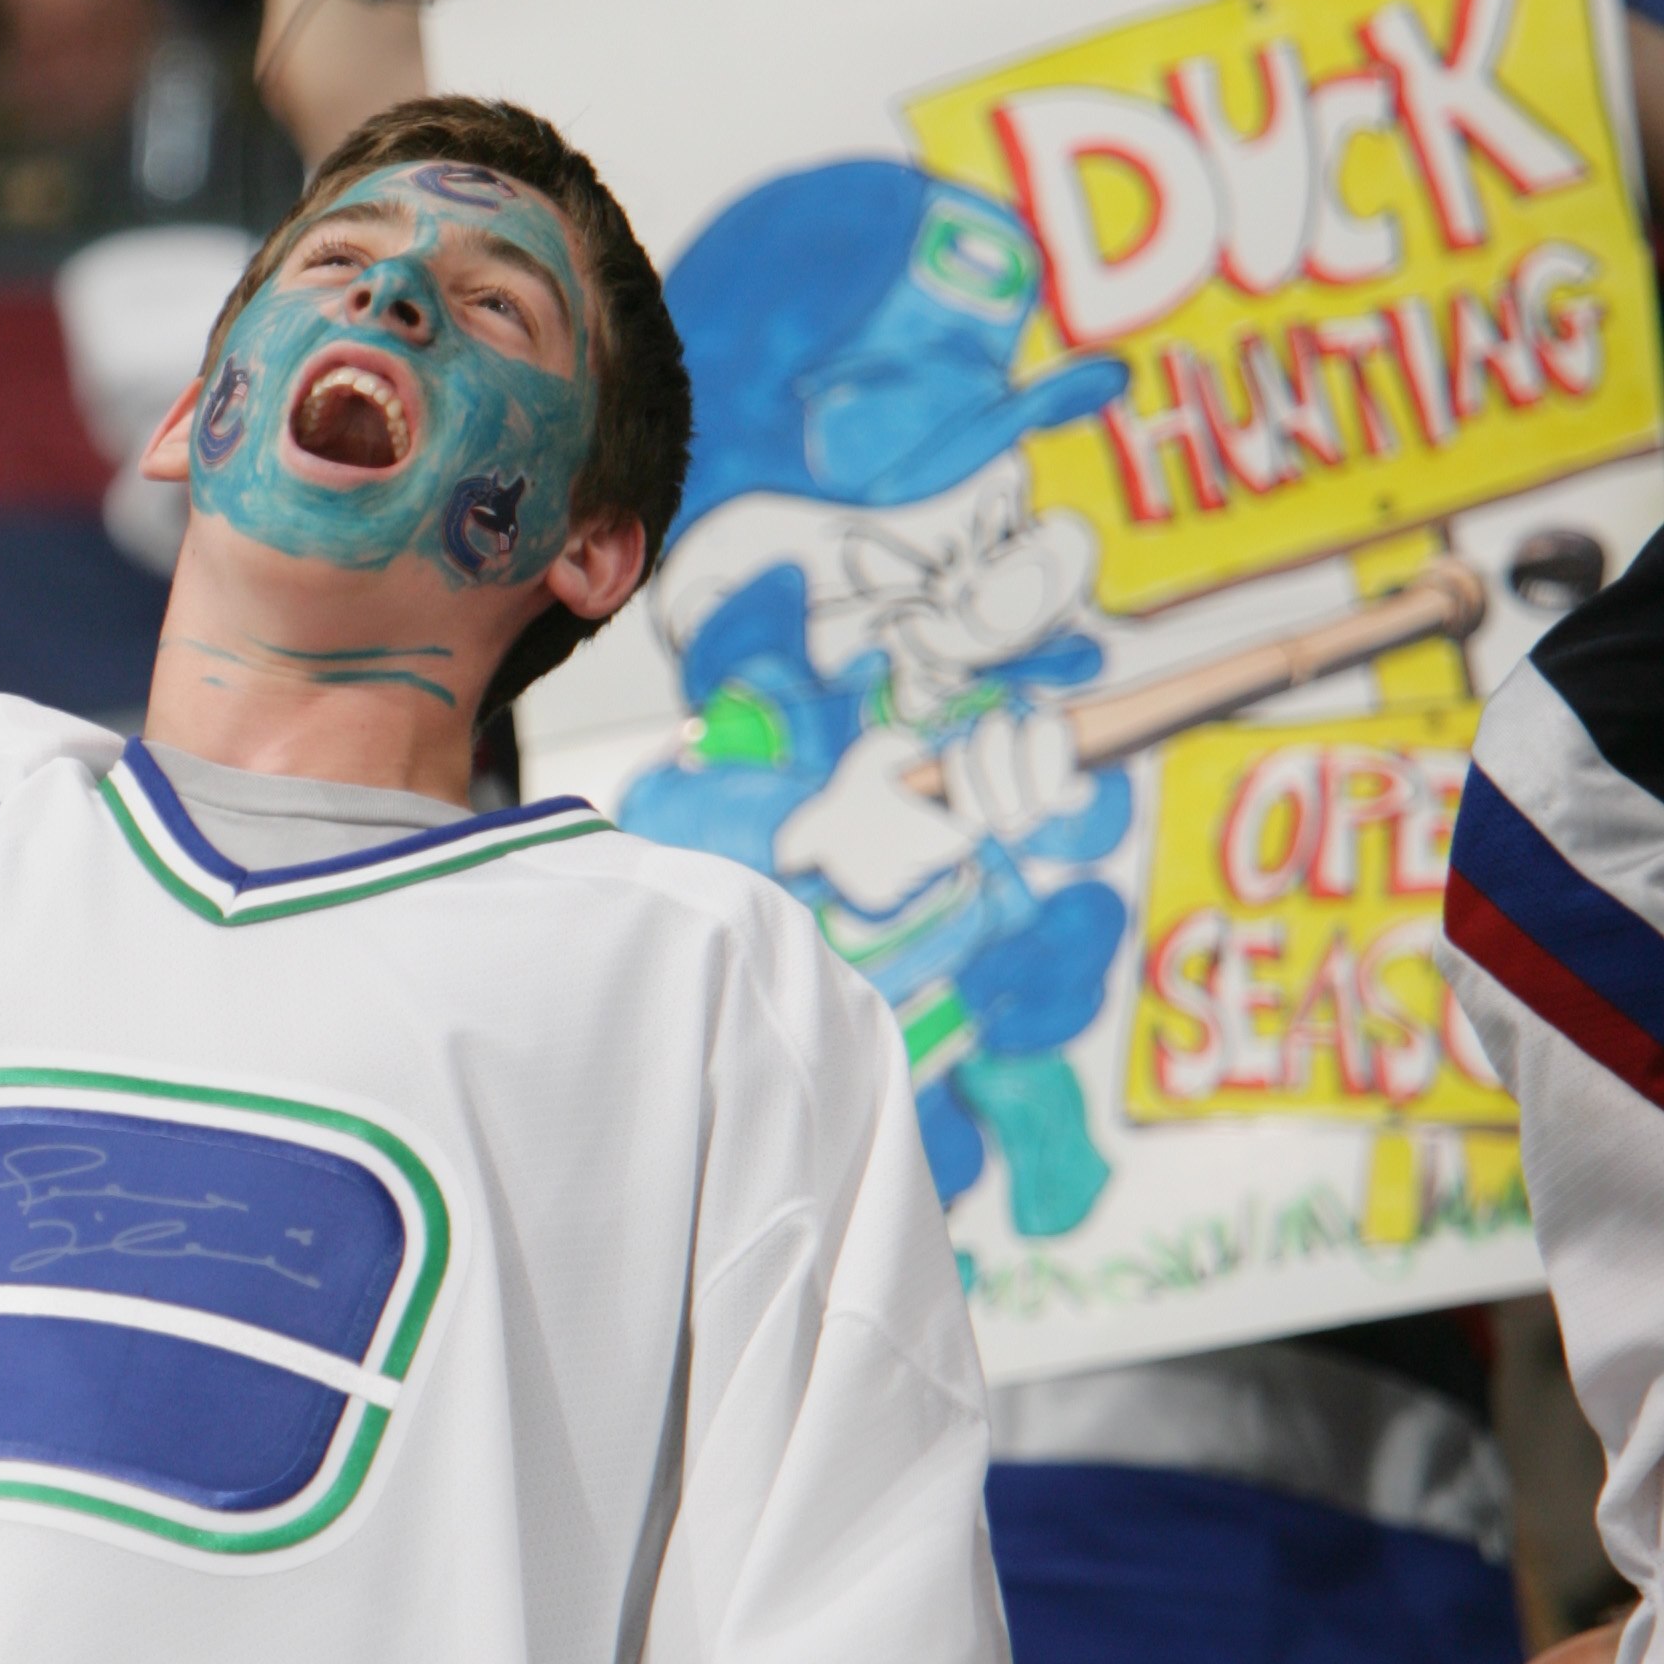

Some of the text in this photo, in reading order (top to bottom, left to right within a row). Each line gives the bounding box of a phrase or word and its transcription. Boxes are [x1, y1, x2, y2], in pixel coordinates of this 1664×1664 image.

[1100, 241, 1606, 524] HUNTING
[1222, 744, 1470, 906] OPE
[1148, 906, 1518, 1107] SEAS
